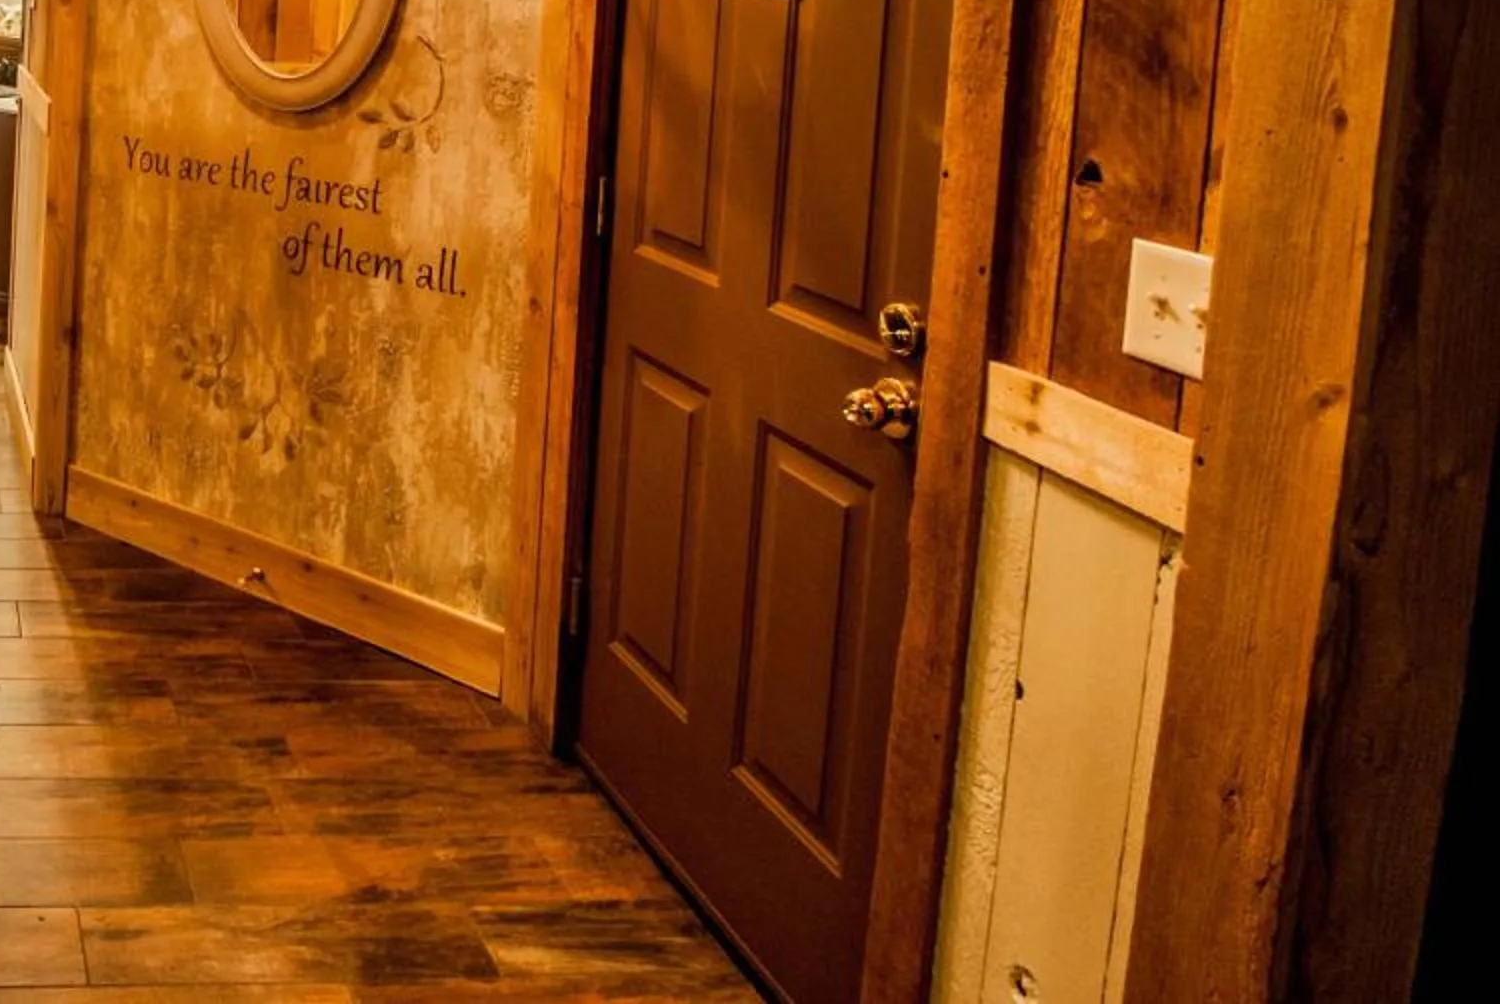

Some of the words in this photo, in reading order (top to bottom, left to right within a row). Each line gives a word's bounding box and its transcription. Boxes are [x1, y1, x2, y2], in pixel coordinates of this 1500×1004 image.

[123, 135, 171, 177] You
[178, 156, 222, 186] are
[230, 148, 275, 194] the
[275, 157, 383, 215] fairest
[282, 222, 321, 276] of
[322, 228, 404, 285] them
[415, 248, 467, 298] all.
